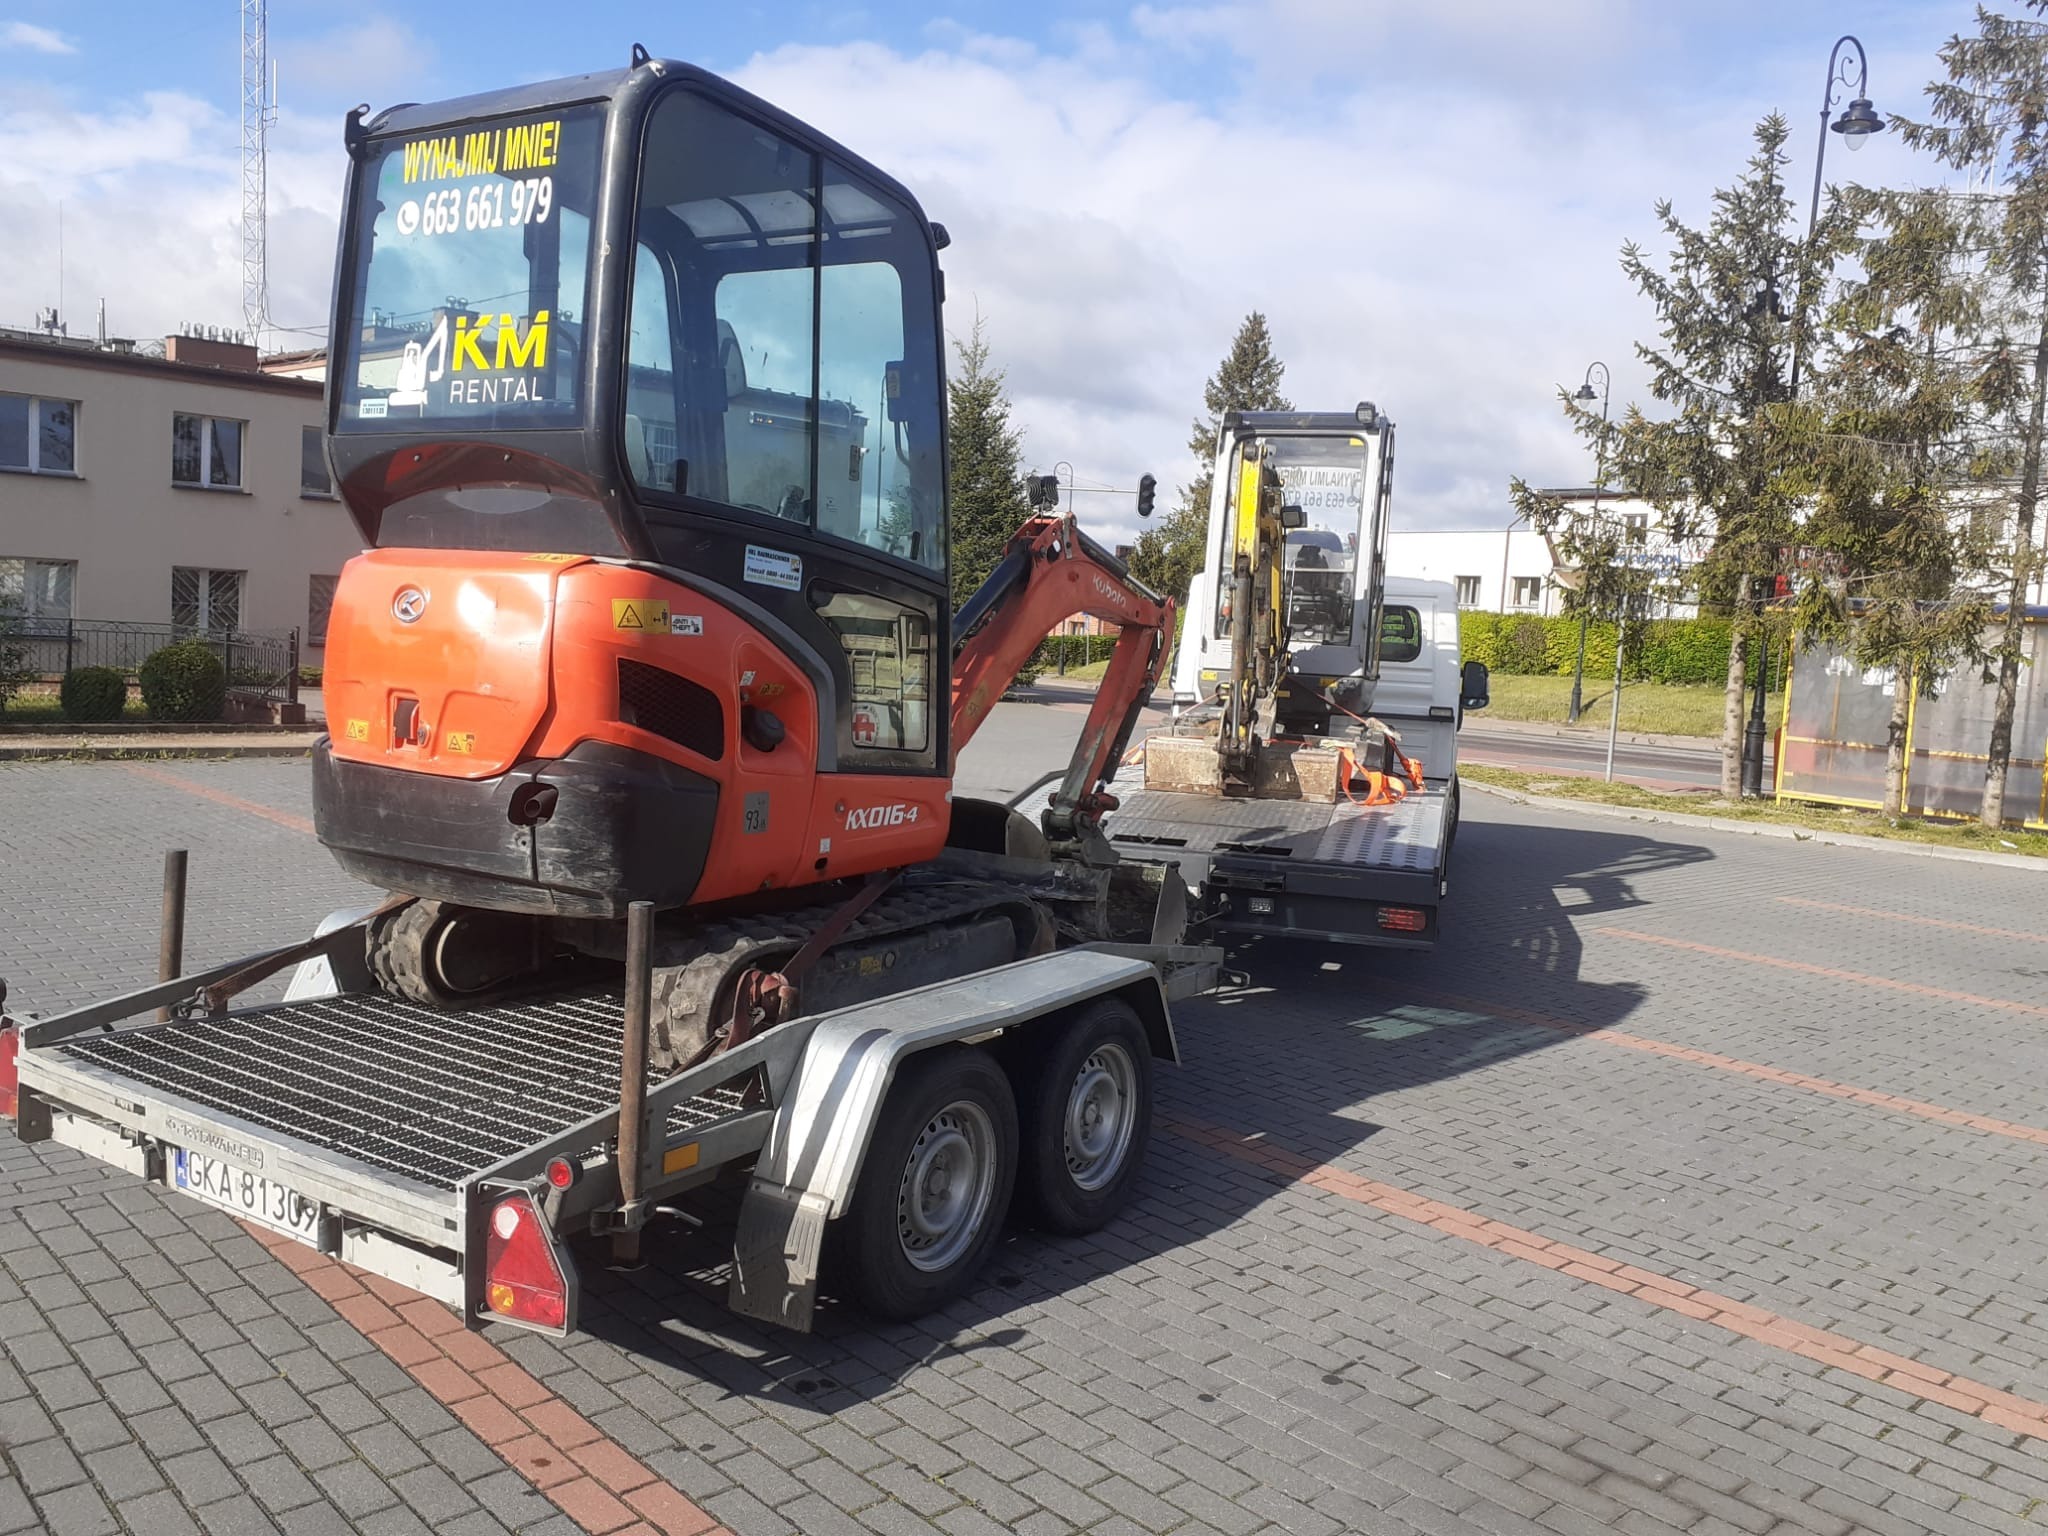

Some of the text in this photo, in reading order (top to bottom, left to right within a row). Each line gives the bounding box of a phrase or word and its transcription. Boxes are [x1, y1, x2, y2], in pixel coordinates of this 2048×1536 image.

[404, 120, 561, 184] WYNAJMIJ MNIE!
[422, 176, 553, 236] 663 661 979
[452, 310, 550, 372] KM
[449, 377, 544, 404] RENTAL
[745, 809, 760, 831] 93
[188, 1150, 233, 1202] GKA
